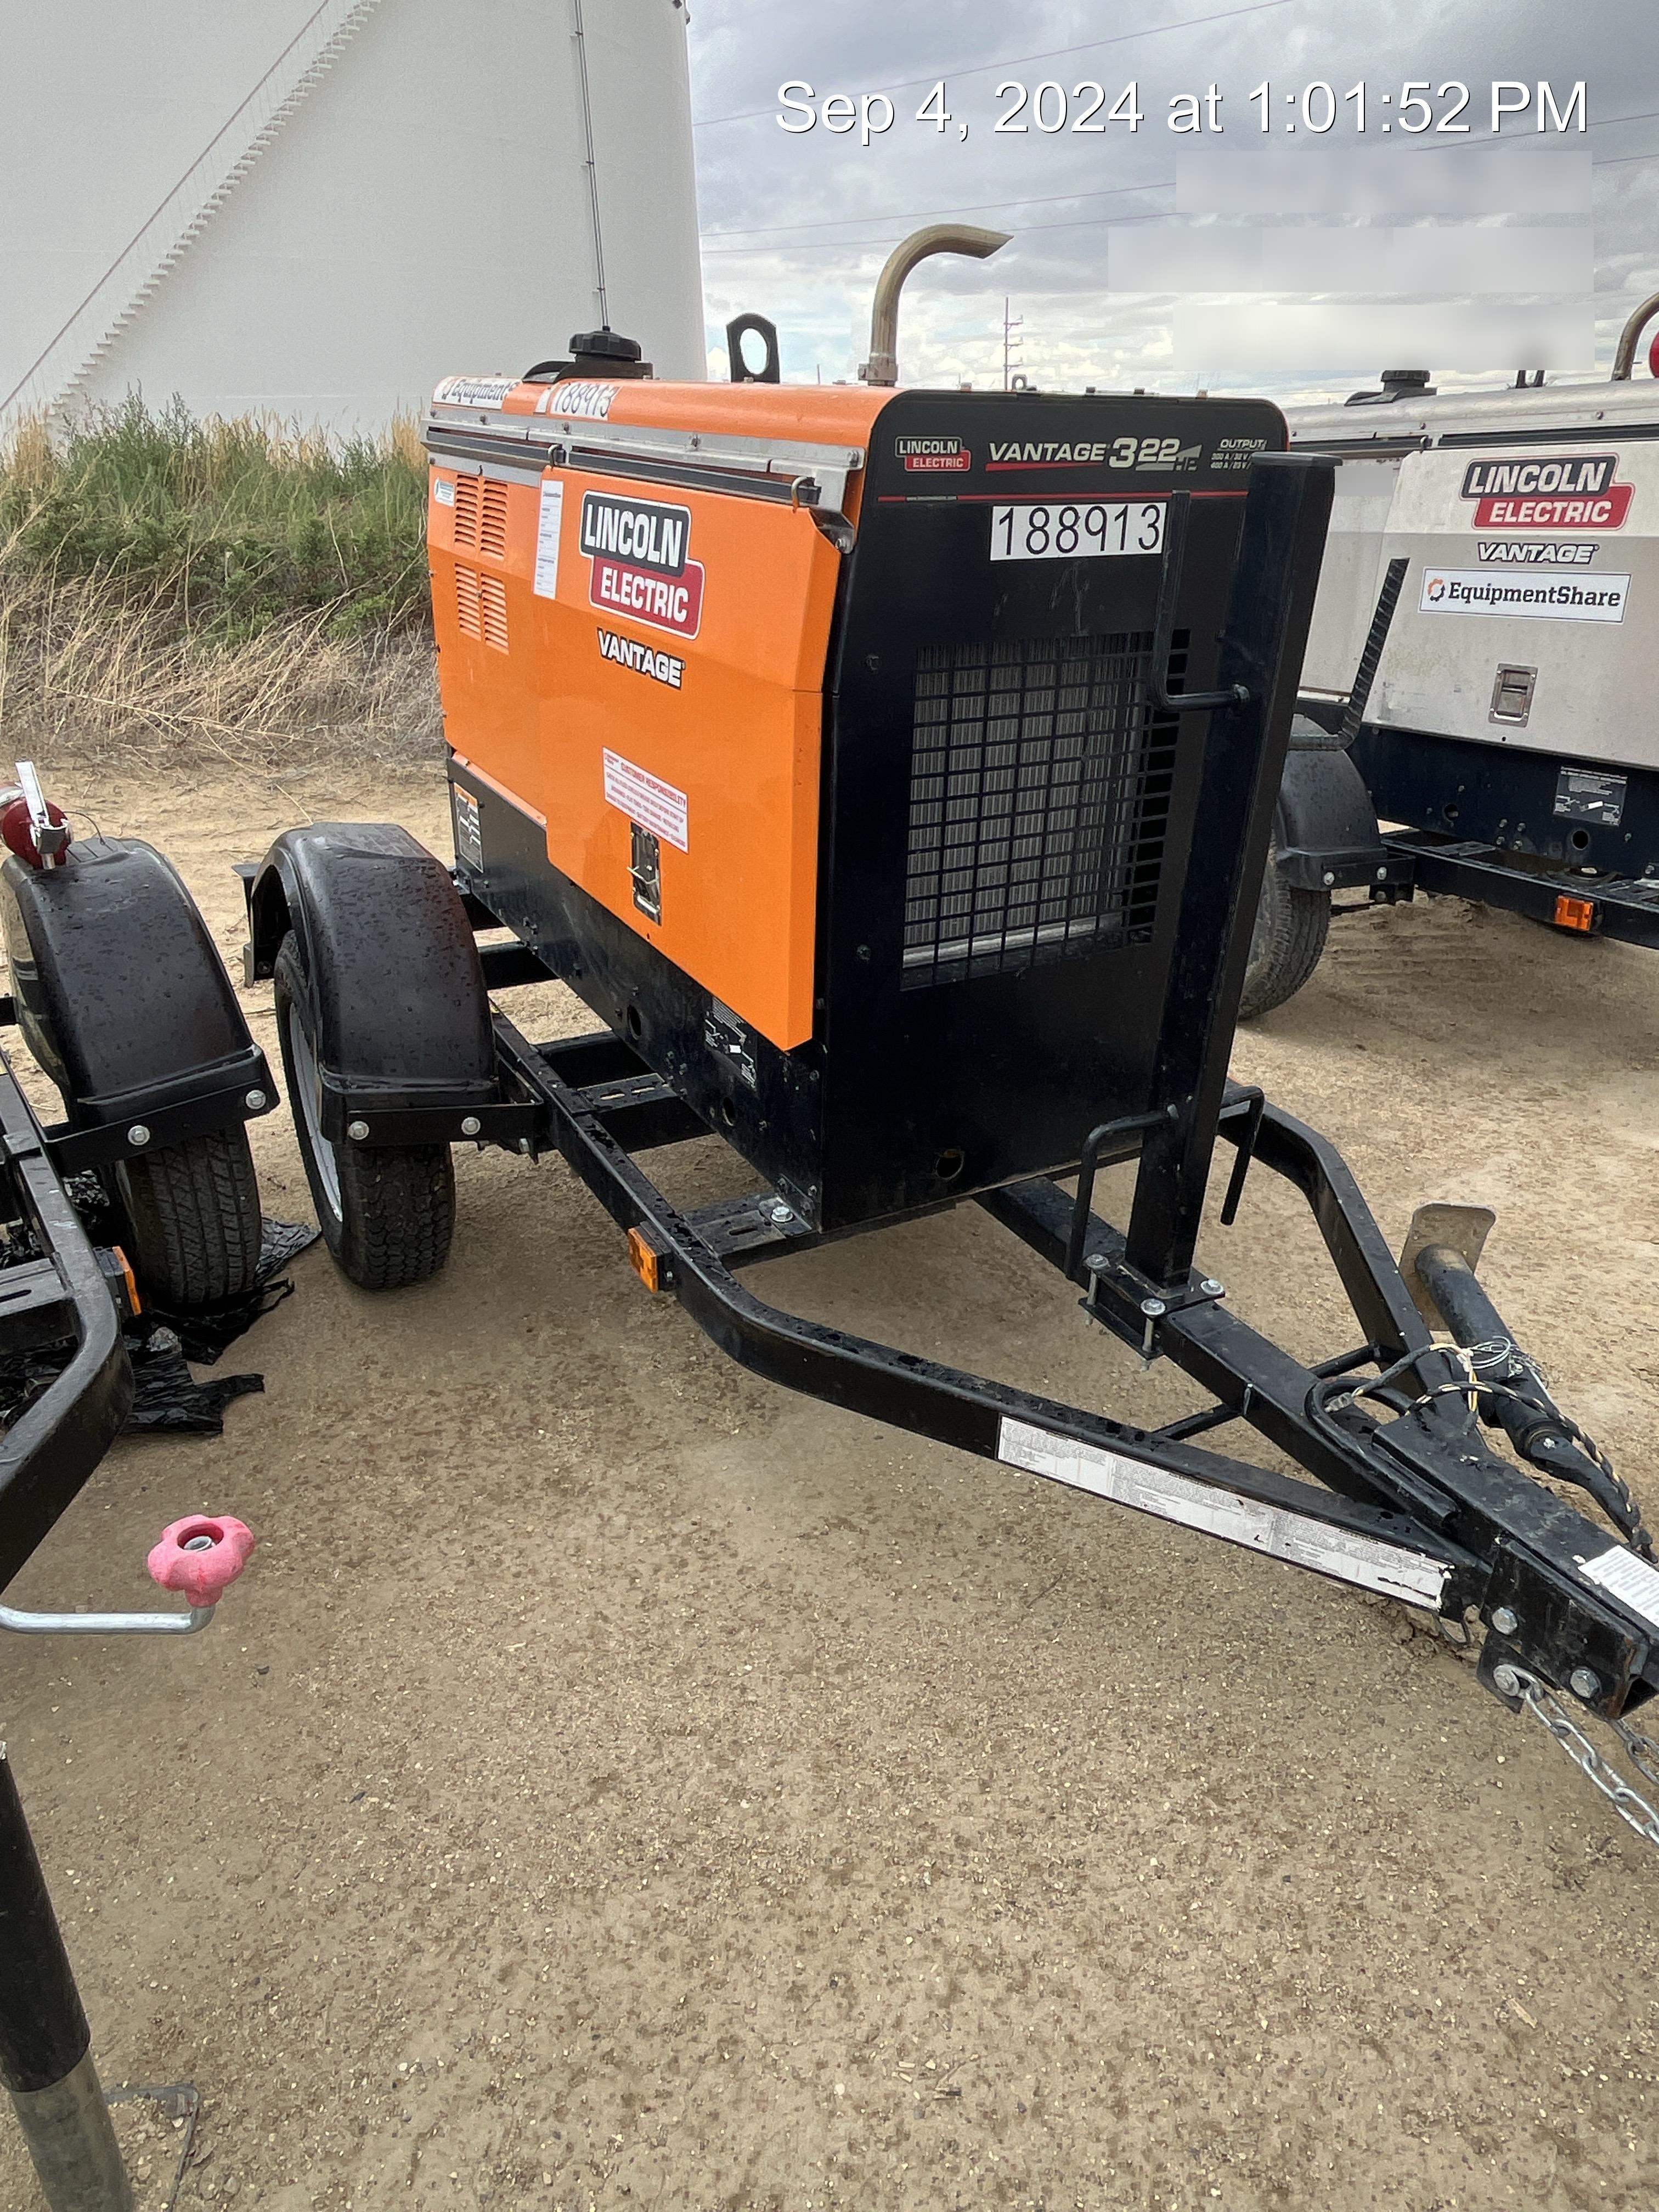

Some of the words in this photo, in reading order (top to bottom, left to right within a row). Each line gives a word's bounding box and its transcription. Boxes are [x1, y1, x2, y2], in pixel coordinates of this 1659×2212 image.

[555, 382, 619, 417] 188913
[899, 441, 958, 454] LINCOLN
[989, 443, 1107, 461] VANTAGE
[1109, 437, 1181, 469] 322
[1220, 438, 1265, 449] OUTPUT
[913, 458, 964, 467] ELECTRIC
[1468, 462, 1608, 493] LINCOLN
[1489, 500, 1612, 522] ELECTRIC
[584, 504, 682, 568] LINCOLN
[999, 504, 1160, 555] 188913
[1478, 543, 1594, 563] VANTAGE
[600, 566, 689, 623] ELECTRIC
[1448, 582, 1621, 607] EquipmentShare
[597, 630, 682, 687] VANTAGE
